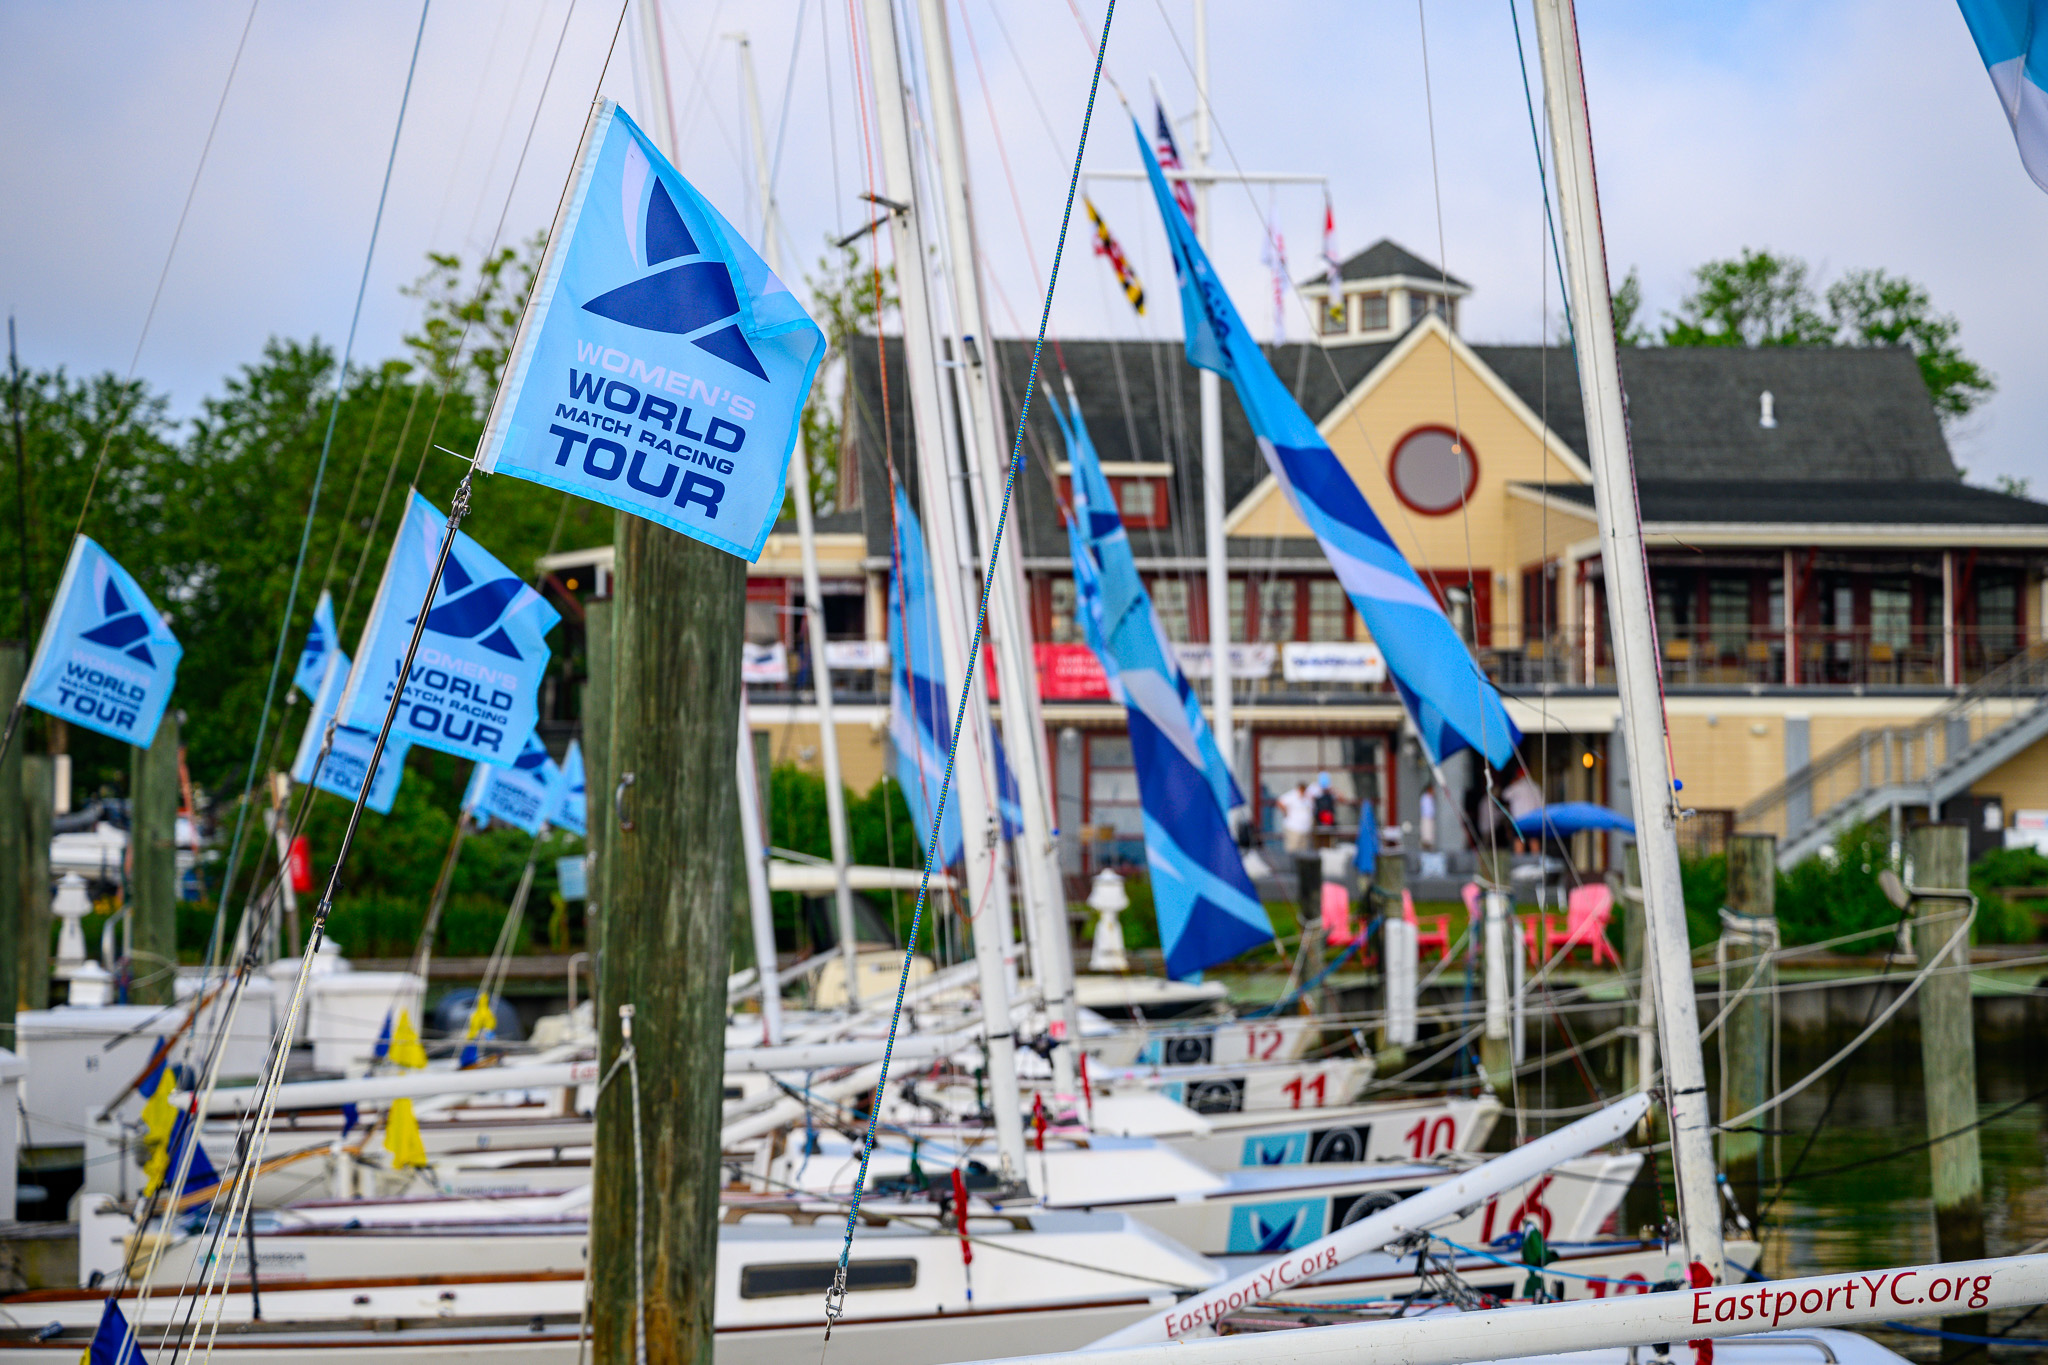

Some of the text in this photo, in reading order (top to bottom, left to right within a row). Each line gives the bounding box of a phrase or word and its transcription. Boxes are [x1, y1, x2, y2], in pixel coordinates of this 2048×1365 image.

[577, 339, 756, 421] WOMEN'S
[569, 367, 746, 453] WORLD
[555, 403, 735, 475] MATCH RACING
[549, 423, 726, 519] TOUR
[58, 686, 137, 730] TOUR
[67, 661, 146, 702] WORLD
[395, 658, 513, 711] WORLD
[449, 699, 508, 725] RACING
[1246, 1023, 1283, 1060] 12
[1282, 1073, 1327, 1109] 11
[1405, 1116, 1455, 1158] 10
[1481, 1174, 1554, 1243] 16
[1165, 1246, 1338, 1339] EastportYC.org
[1692, 1272, 1992, 1327] EastportYC.org
